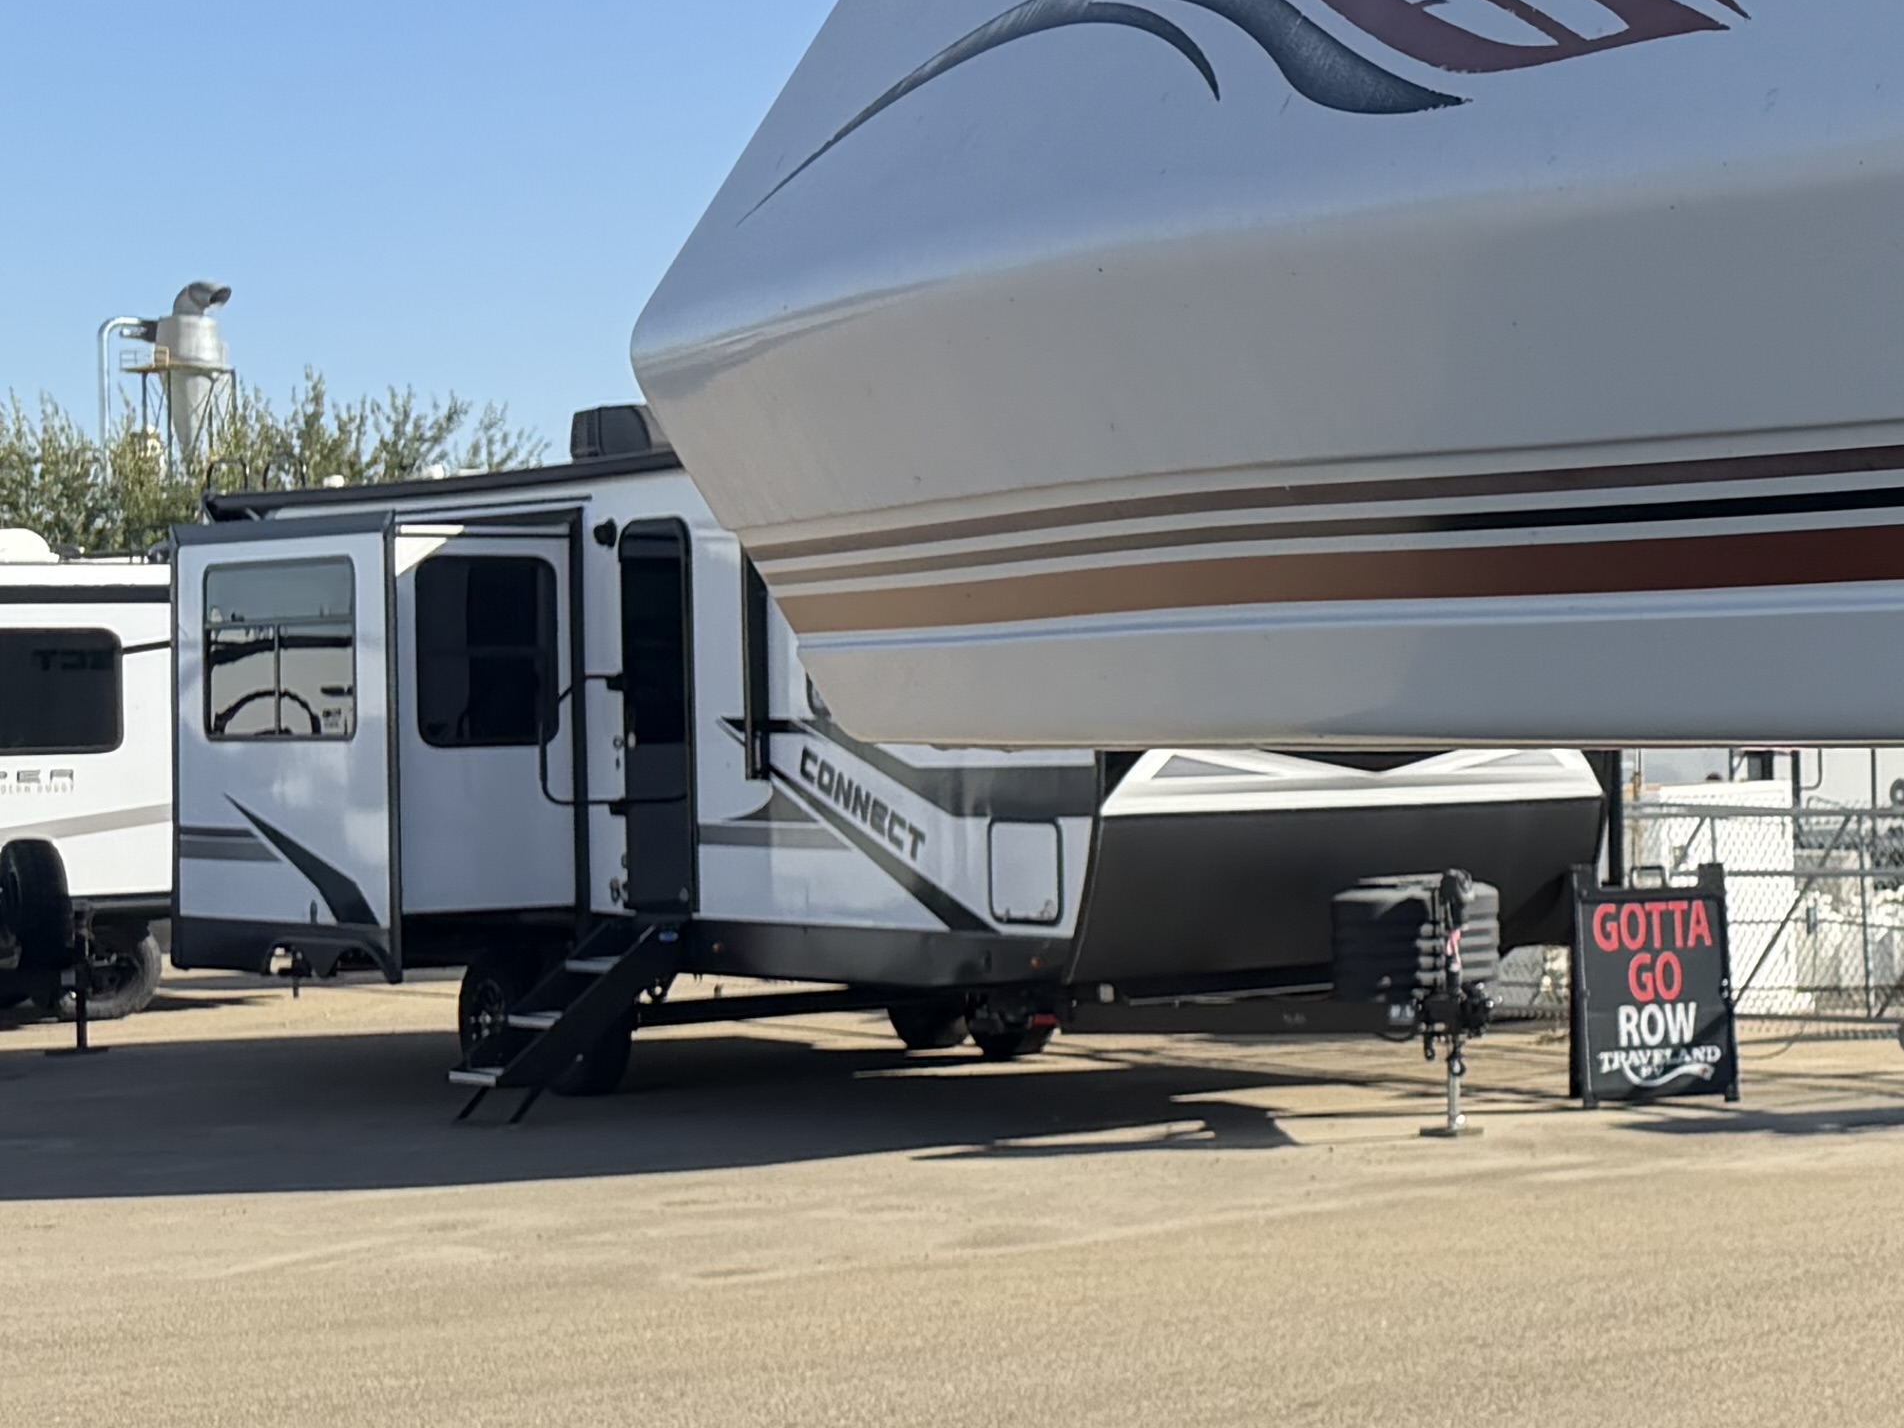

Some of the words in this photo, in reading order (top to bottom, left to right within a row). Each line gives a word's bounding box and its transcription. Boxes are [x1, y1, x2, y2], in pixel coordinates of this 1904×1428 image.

[800, 745, 926, 862] CONNECT
[1592, 899, 1713, 952] GOTTA
[1628, 950, 1683, 1002] GO
[1617, 1001, 1697, 1047] ROW
[1597, 1044, 1722, 1074] TRAVELAND
